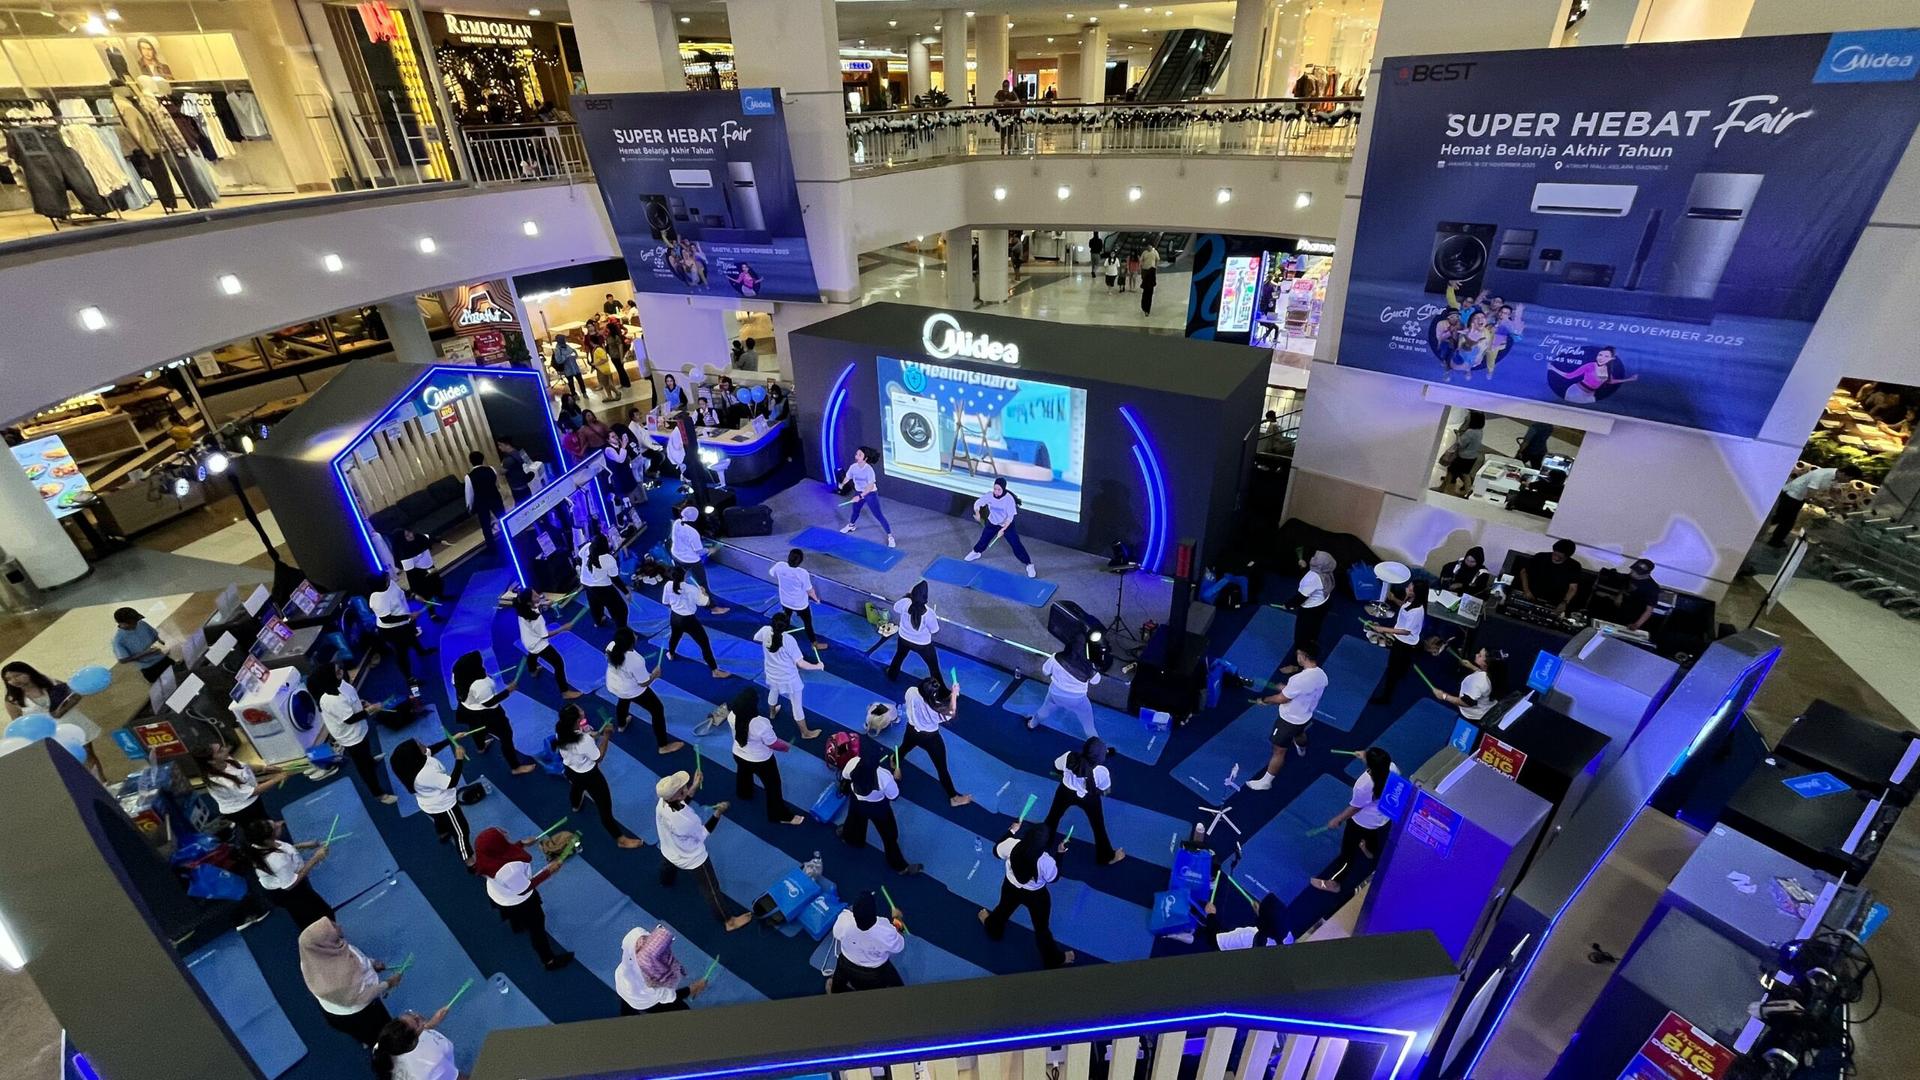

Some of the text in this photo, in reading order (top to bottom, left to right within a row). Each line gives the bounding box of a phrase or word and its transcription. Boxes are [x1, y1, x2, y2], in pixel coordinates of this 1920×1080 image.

[444, 14, 532, 38] REMBOELAN
[1411, 62, 1478, 82] BEST
[1831, 45, 1913, 73] Midea
[744, 96, 771, 111] Midea
[1445, 94, 1815, 148] SUPER HEBAT Fair
[613, 120, 752, 149] SUPER HEBAT Fair
[619, 146, 714, 156] Hemat Belanja Akhir Tahun
[1440, 143, 1673, 158] Hemat Belanja Akhir Tahun
[1380, 303, 1447, 322] Guest Star
[922, 312, 1020, 365] Midea
[1546, 316, 1745, 347] SABTU, 22 NOVEMBER 2025
[423, 384, 468, 410] Midea
[1481, 750, 1514, 774] BIG
[1660, 1032, 1715, 1074] BIG
[1675, 1029, 1716, 1061] Promo
